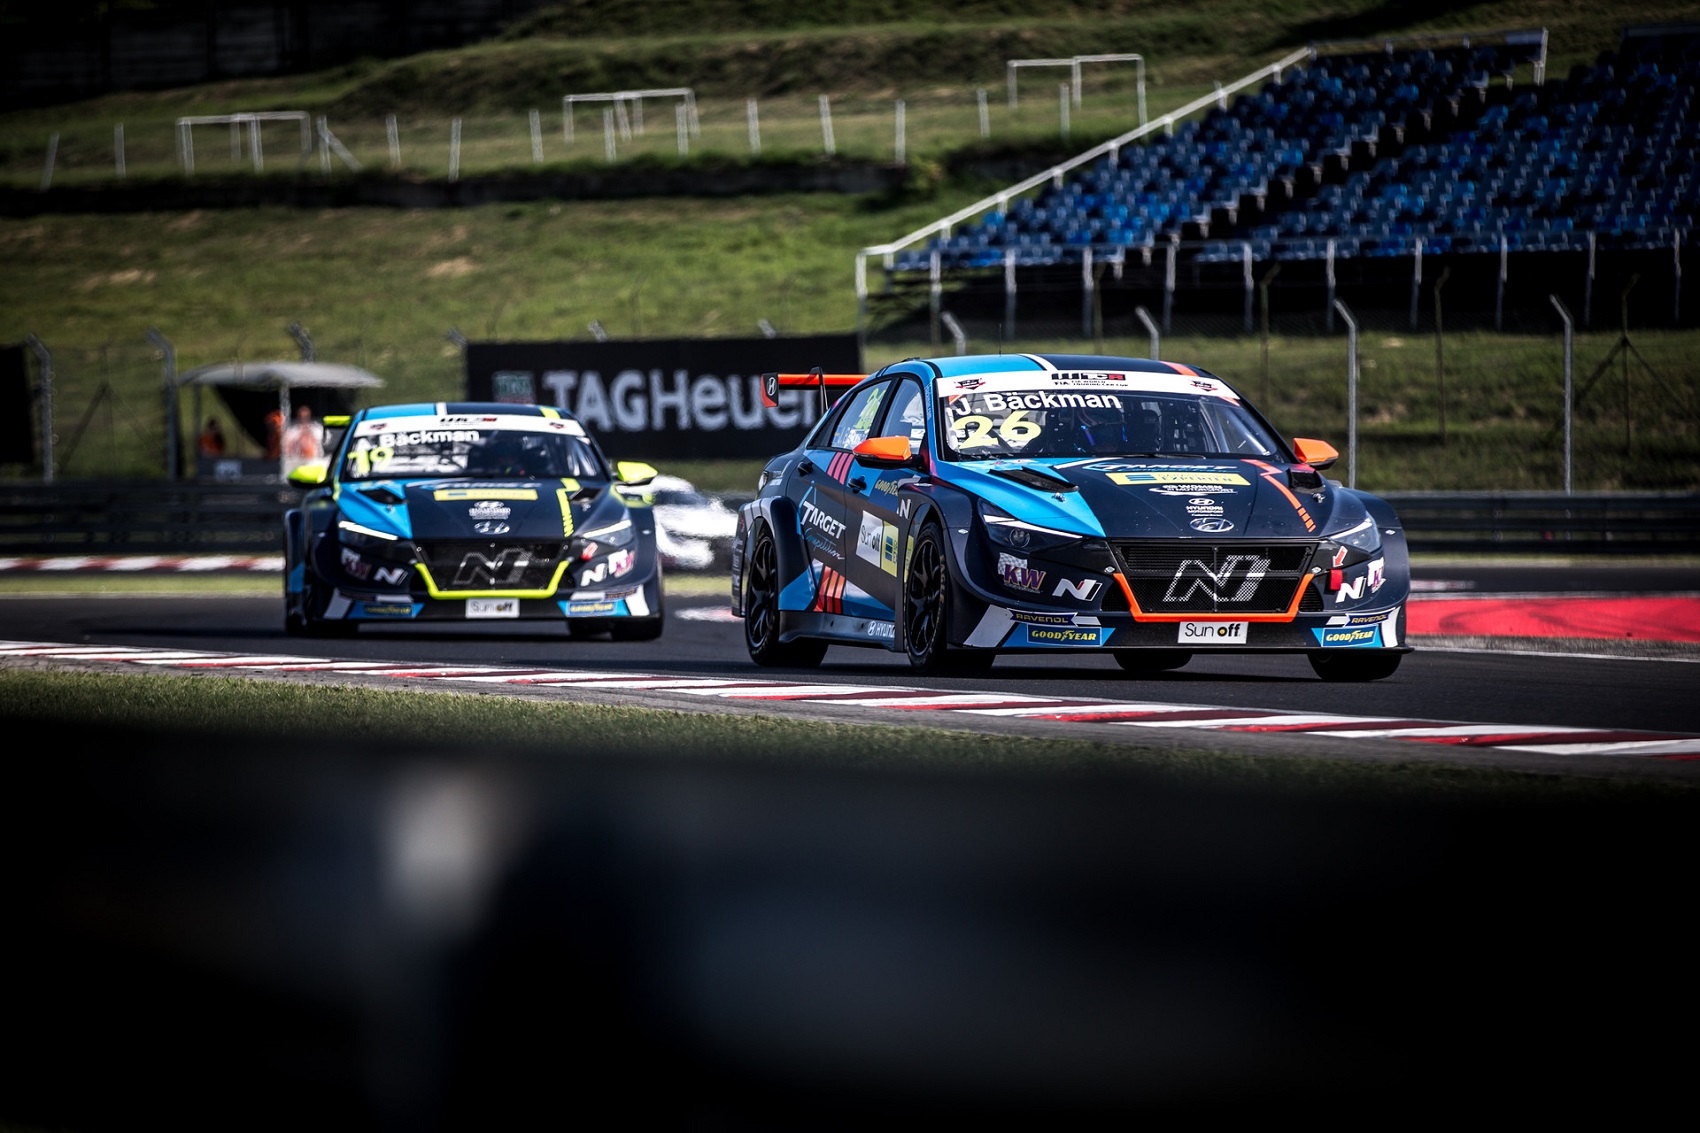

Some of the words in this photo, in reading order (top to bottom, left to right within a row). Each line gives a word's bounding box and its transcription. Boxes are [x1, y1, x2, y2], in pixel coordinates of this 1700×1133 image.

[956, 398, 981, 415] J.
[983, 391, 1122, 411] Bäckman
[951, 410, 1042, 449] 26
[348, 447, 394, 474] 19
[875, 480, 898, 497] GOODYE
[801, 501, 846, 539] TARGET
[1004, 564, 1046, 590] KW
[1016, 613, 1069, 623] RAVENOL
[1031, 630, 1097, 641] GOODYEAR
[1184, 622, 1214, 637] Sun
[1217, 622, 1241, 637] off
[1326, 628, 1373, 642] GOODYEAR
